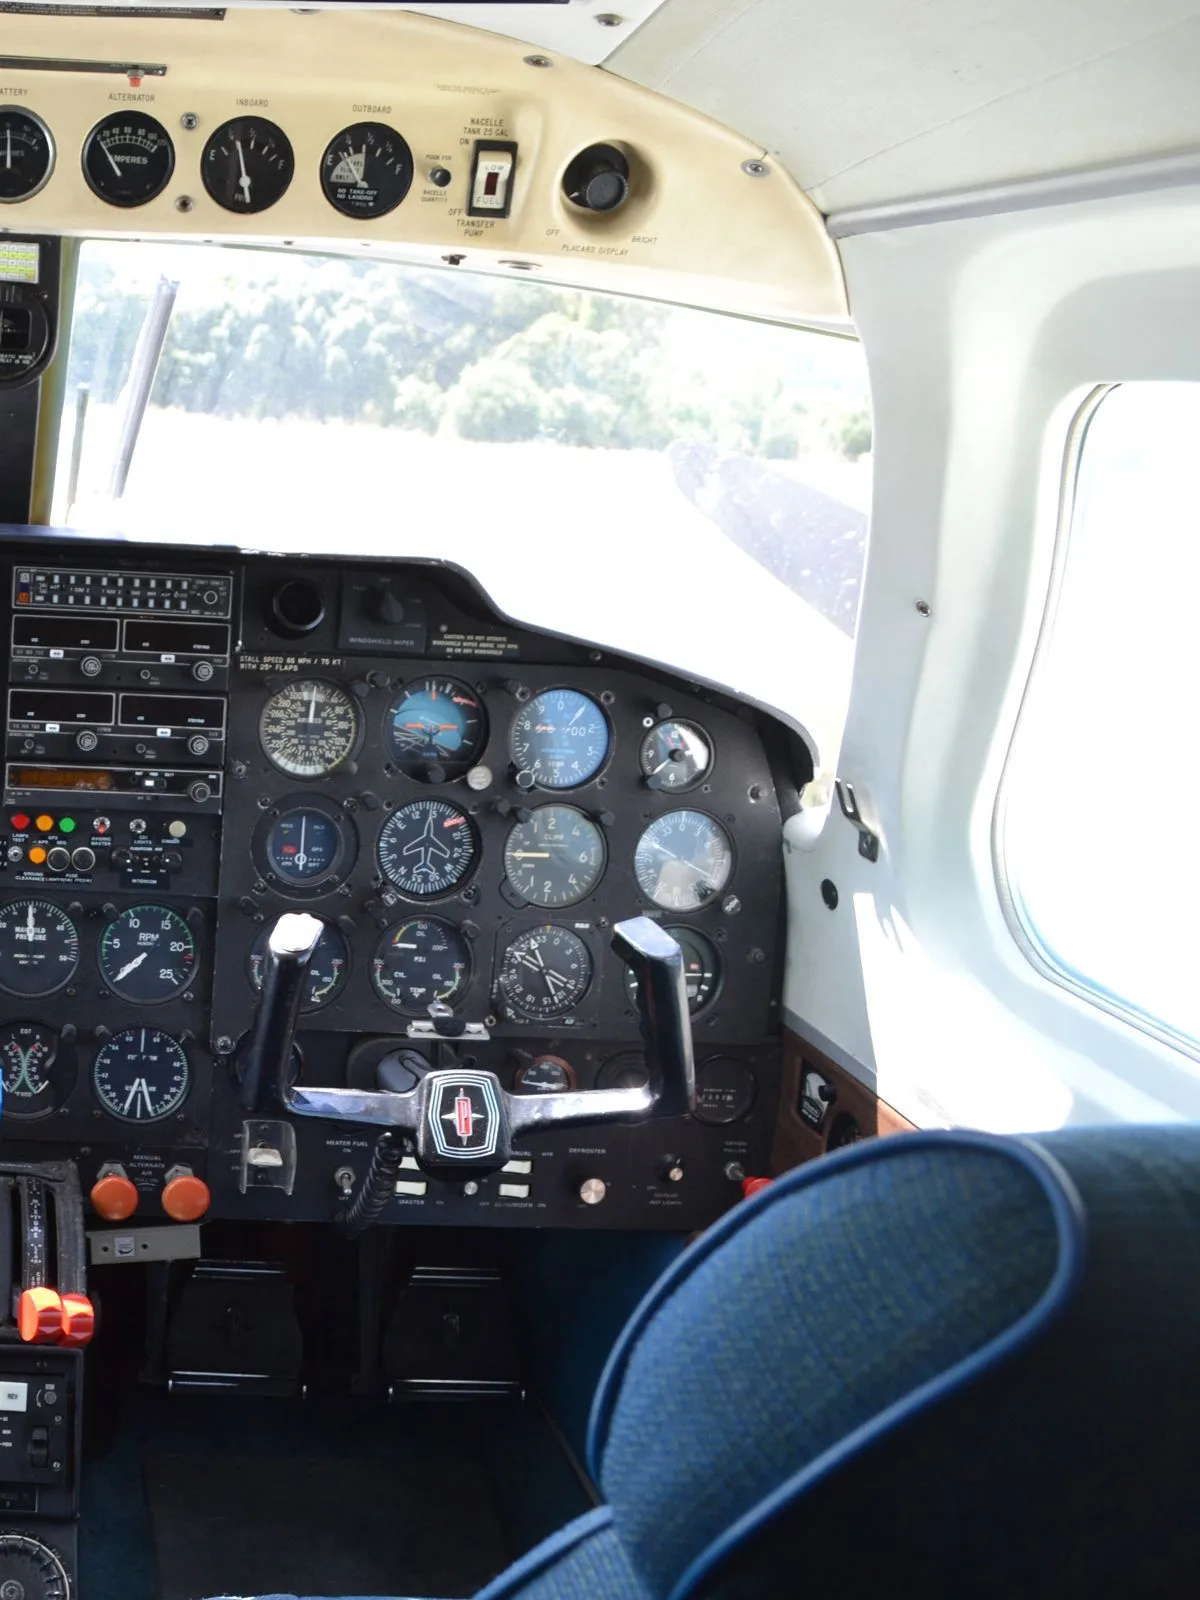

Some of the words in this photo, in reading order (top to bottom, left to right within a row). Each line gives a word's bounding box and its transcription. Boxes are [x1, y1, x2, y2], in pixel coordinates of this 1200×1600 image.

[108, 94, 155, 102] ALTERNATOR
[236, 98, 269, 107] INBOARD
[352, 105, 392, 114] OUTBOARD
[470, 118, 504, 128] NACELLE
[464, 126, 482, 136] TANK
[484, 128, 493, 136] 25
[495, 128, 508, 137] GAL
[209, 150, 215, 160] E
[326, 155, 333, 165] E
[278, 160, 284, 170] F
[396, 164, 402, 174] F
[476, 196, 500, 205] FUEL
[448, 208, 463, 216] OFF
[456, 220, 494, 228] TRANSFER
[464, 228, 484, 237] PUMP
[632, 236, 658, 244] BRIGHT
[561, 244, 595, 254] PLACARD
[599, 247, 629, 256] DISPLAY
[348, 637, 391, 645] WINDSHIELD
[411, 812, 420, 820] 12
[396, 821, 406, 830] E
[398, 866, 407, 875] N
[444, 863, 455, 872] W
[128, 918, 140, 928] 10
[161, 920, 171, 930] 15
[139, 933, 159, 941] RPM
[112, 939, 120, 948] 5
[170, 942, 184, 951] 20
[160, 969, 173, 979] 25
